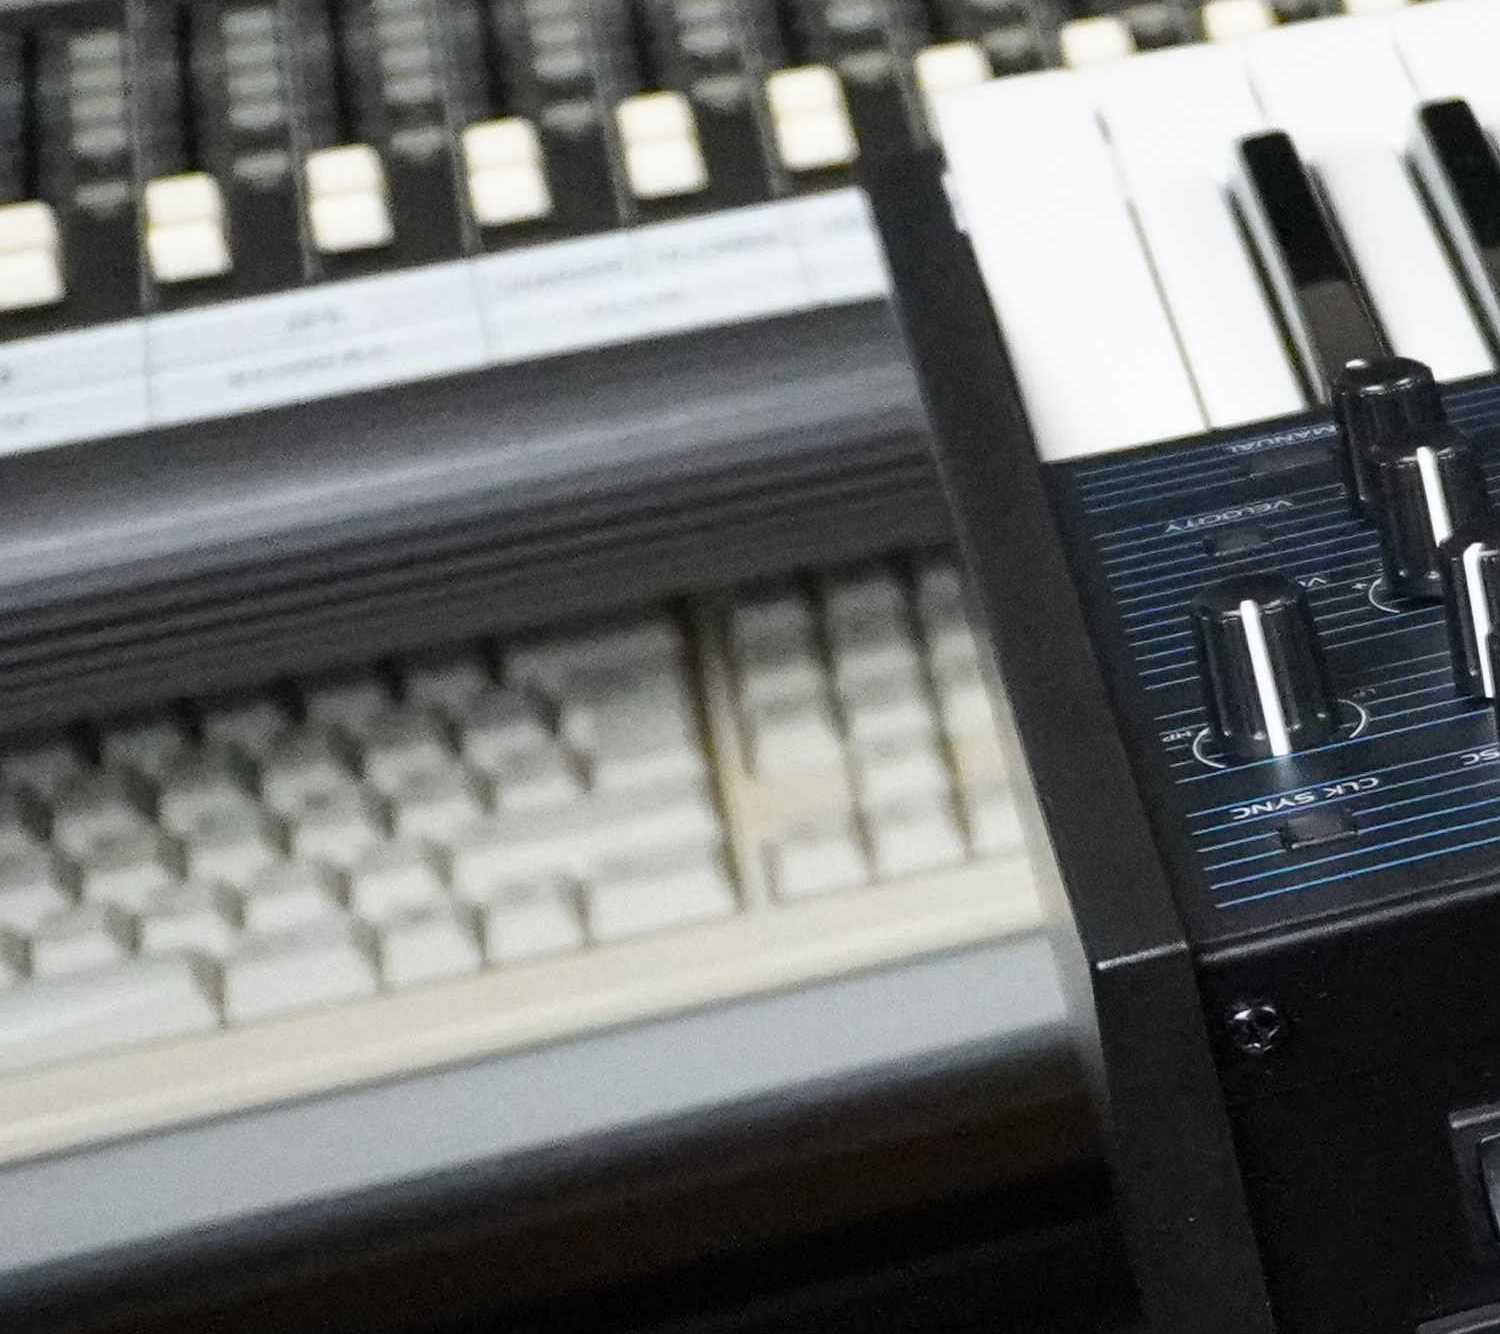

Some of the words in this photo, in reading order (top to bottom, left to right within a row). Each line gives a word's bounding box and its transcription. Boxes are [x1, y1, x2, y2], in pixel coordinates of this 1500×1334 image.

[1228, 423, 1337, 455] MANUAL
[1163, 499, 1293, 532] VELOCITY
[1323, 776, 1381, 800] CLK
[1230, 788, 1313, 823] SYNC
